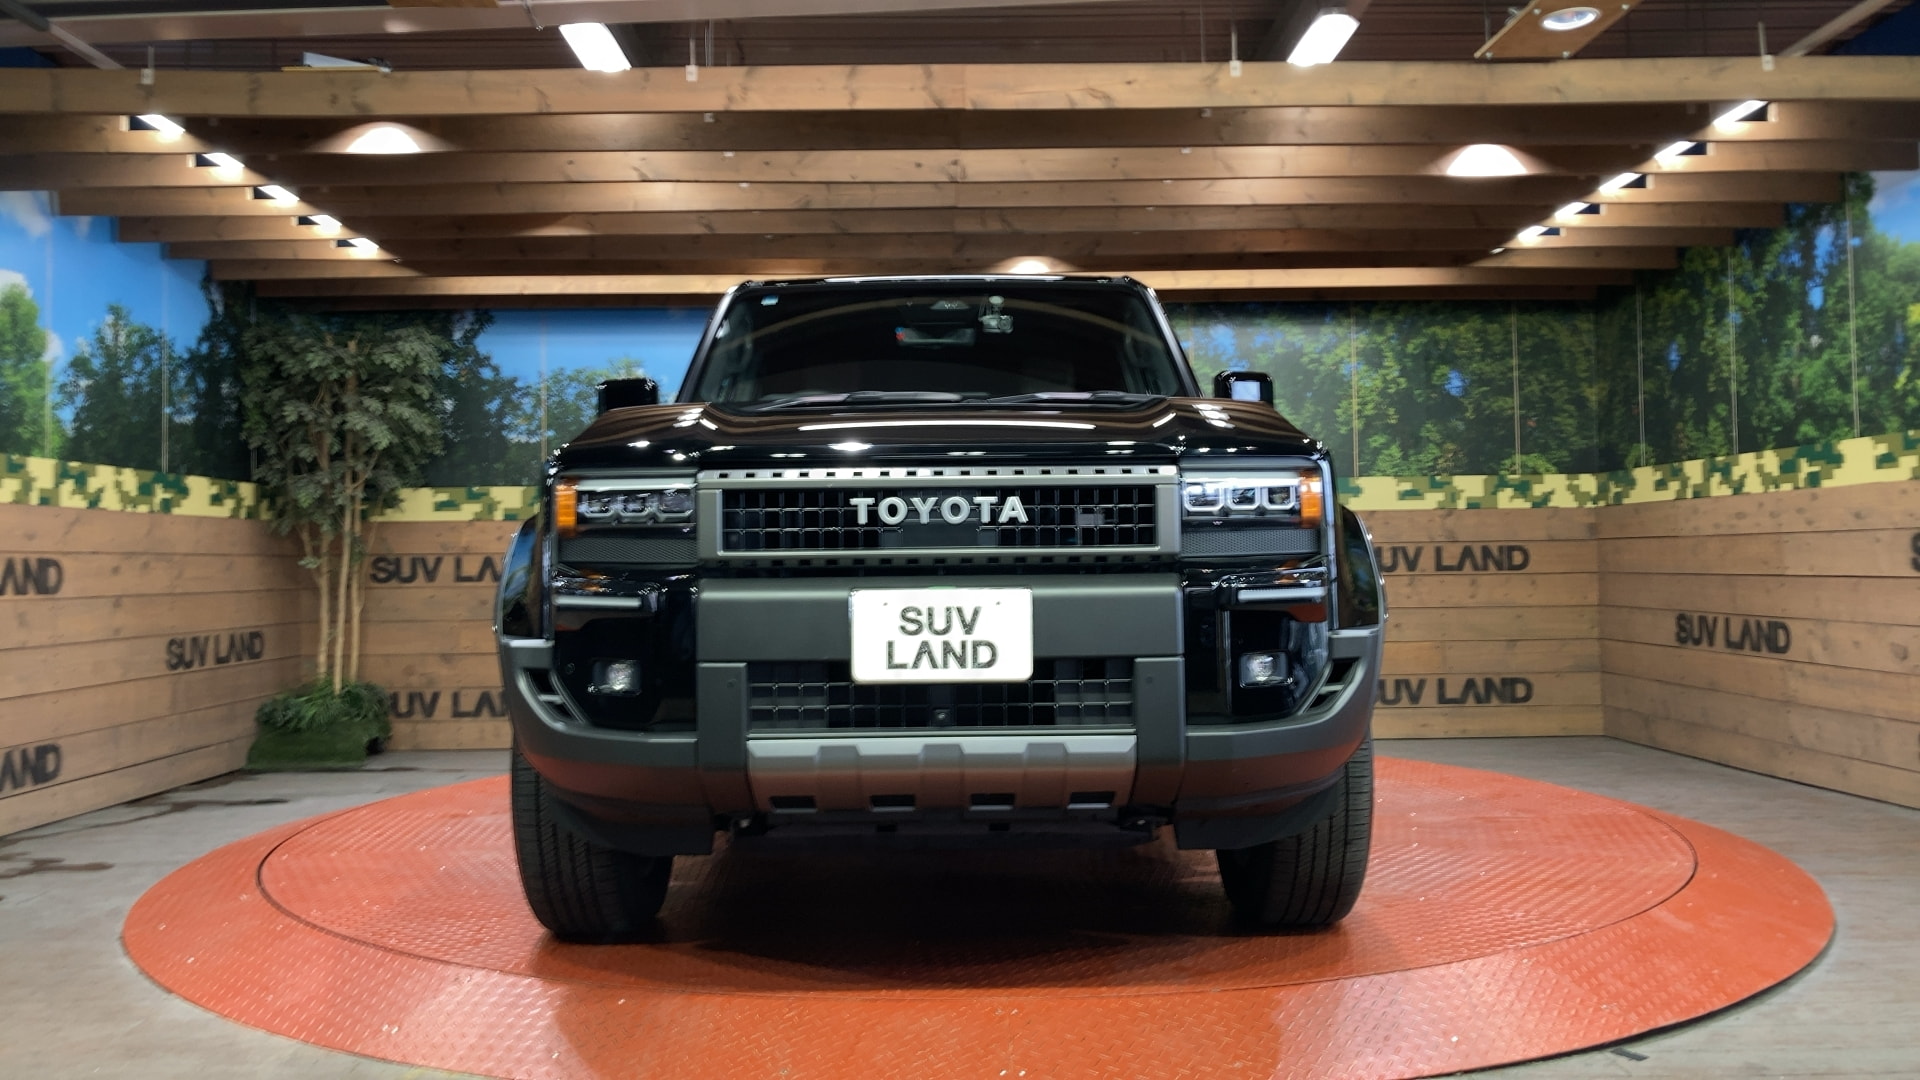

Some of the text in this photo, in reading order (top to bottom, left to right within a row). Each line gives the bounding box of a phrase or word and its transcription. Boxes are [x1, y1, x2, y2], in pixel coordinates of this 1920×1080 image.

[849, 496, 1029, 526] TOYOTA
[369, 556, 503, 583] SUV LA
[1373, 544, 1530, 573] UV LAND
[899, 605, 982, 636] SUV
[1676, 613, 1791, 654] SUV LAND
[166, 631, 264, 671] SUV LAND
[886, 640, 998, 670] LAND
[388, 691, 441, 718] UV
[1376, 677, 1533, 705] UV LAND
